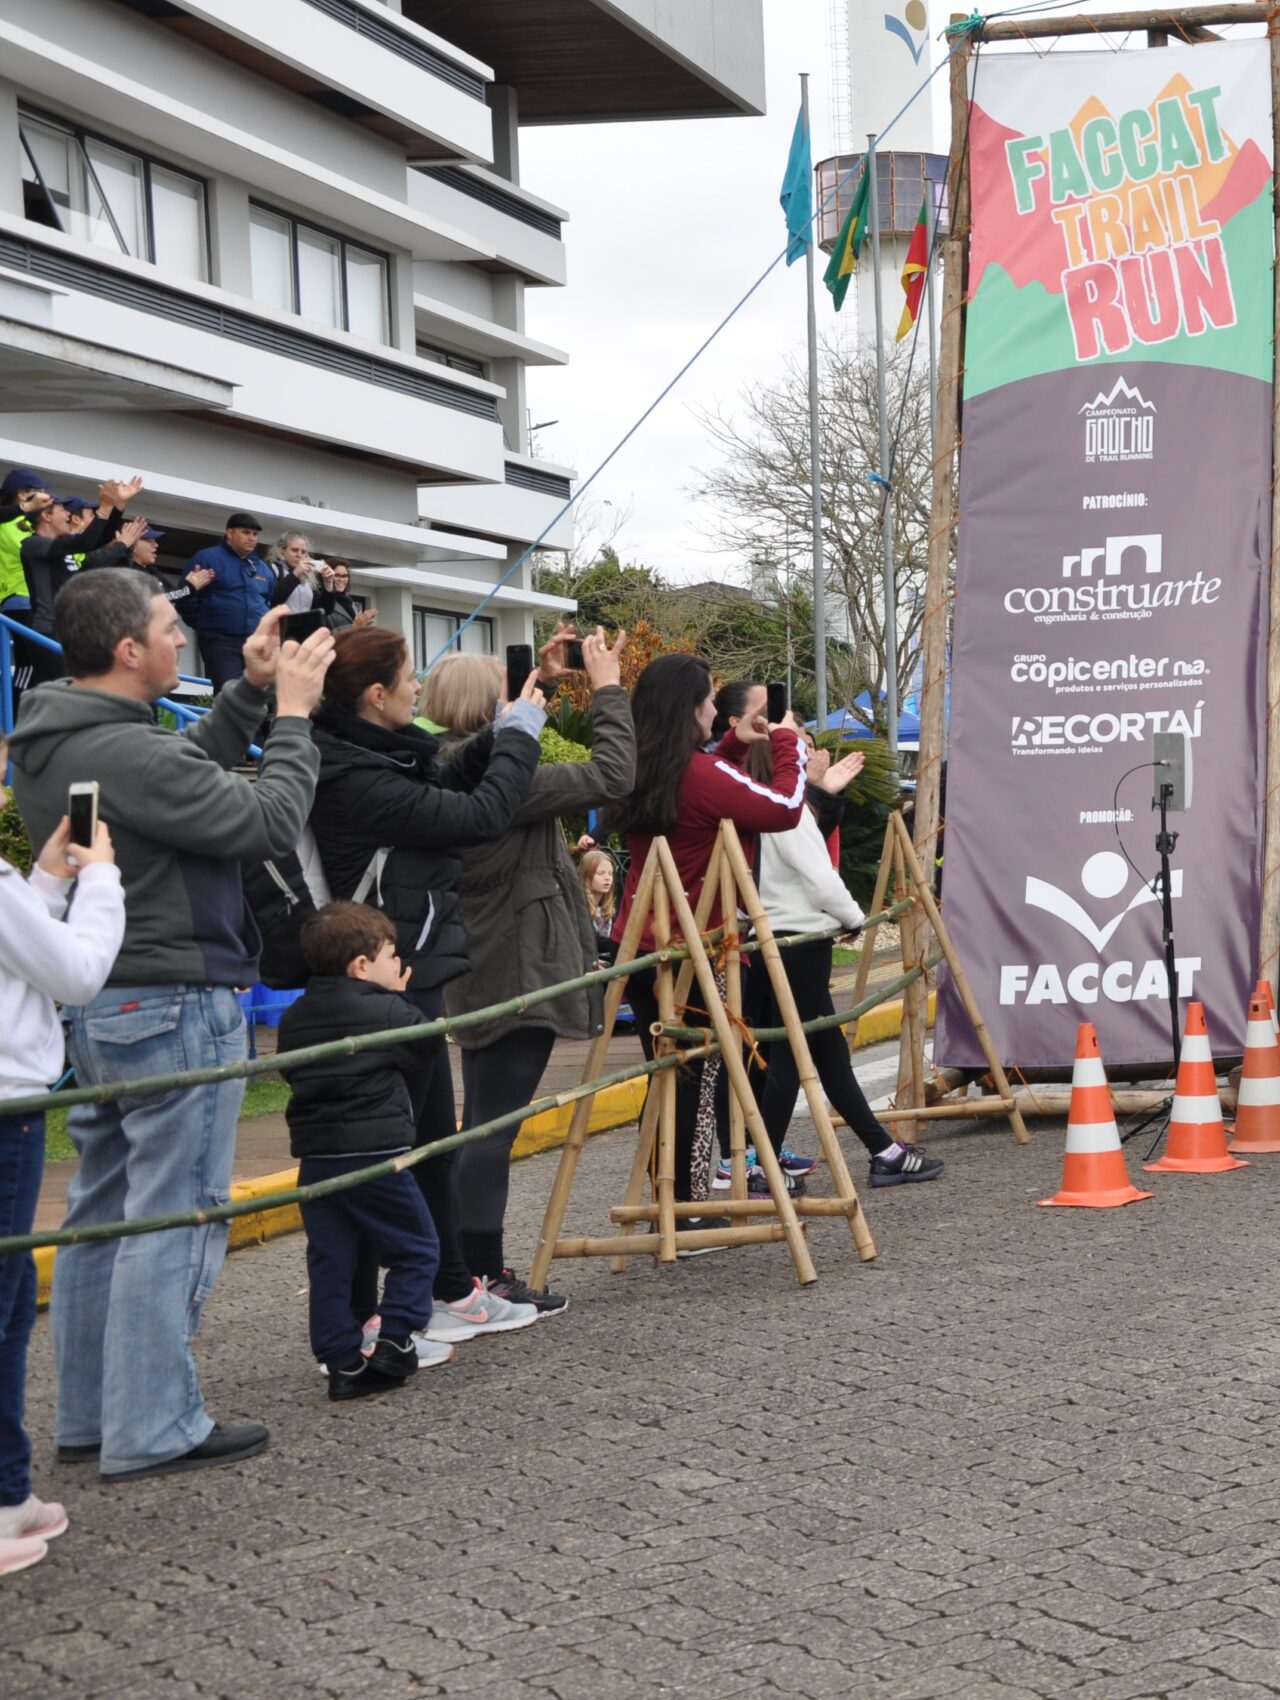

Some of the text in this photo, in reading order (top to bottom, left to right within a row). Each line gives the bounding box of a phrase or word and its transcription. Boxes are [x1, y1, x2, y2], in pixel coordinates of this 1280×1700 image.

[1006, 85, 1230, 214] FACCAT
[1052, 175, 1221, 267] TRAIL
[1062, 237, 1237, 360] RUN
[1085, 407, 1137, 417] CAMPEONATO
[1120, 452, 1154, 461] RUNNING
[1082, 492, 1148, 510] PATROCÍNIO:
[1003, 571, 1222, 614] construarte
[1034, 609, 1152, 624] engenharia & construção
[1014, 654, 1046, 663] GRUPO
[1010, 654, 1170, 688] copicenter
[1055, 684, 1094, 694] produtos
[1103, 682, 1138, 693] serviços
[1139, 678, 1202, 691] personalizados
[1012, 748, 1077, 756] Transformando
[999, 957, 1201, 1005] FACCAT
